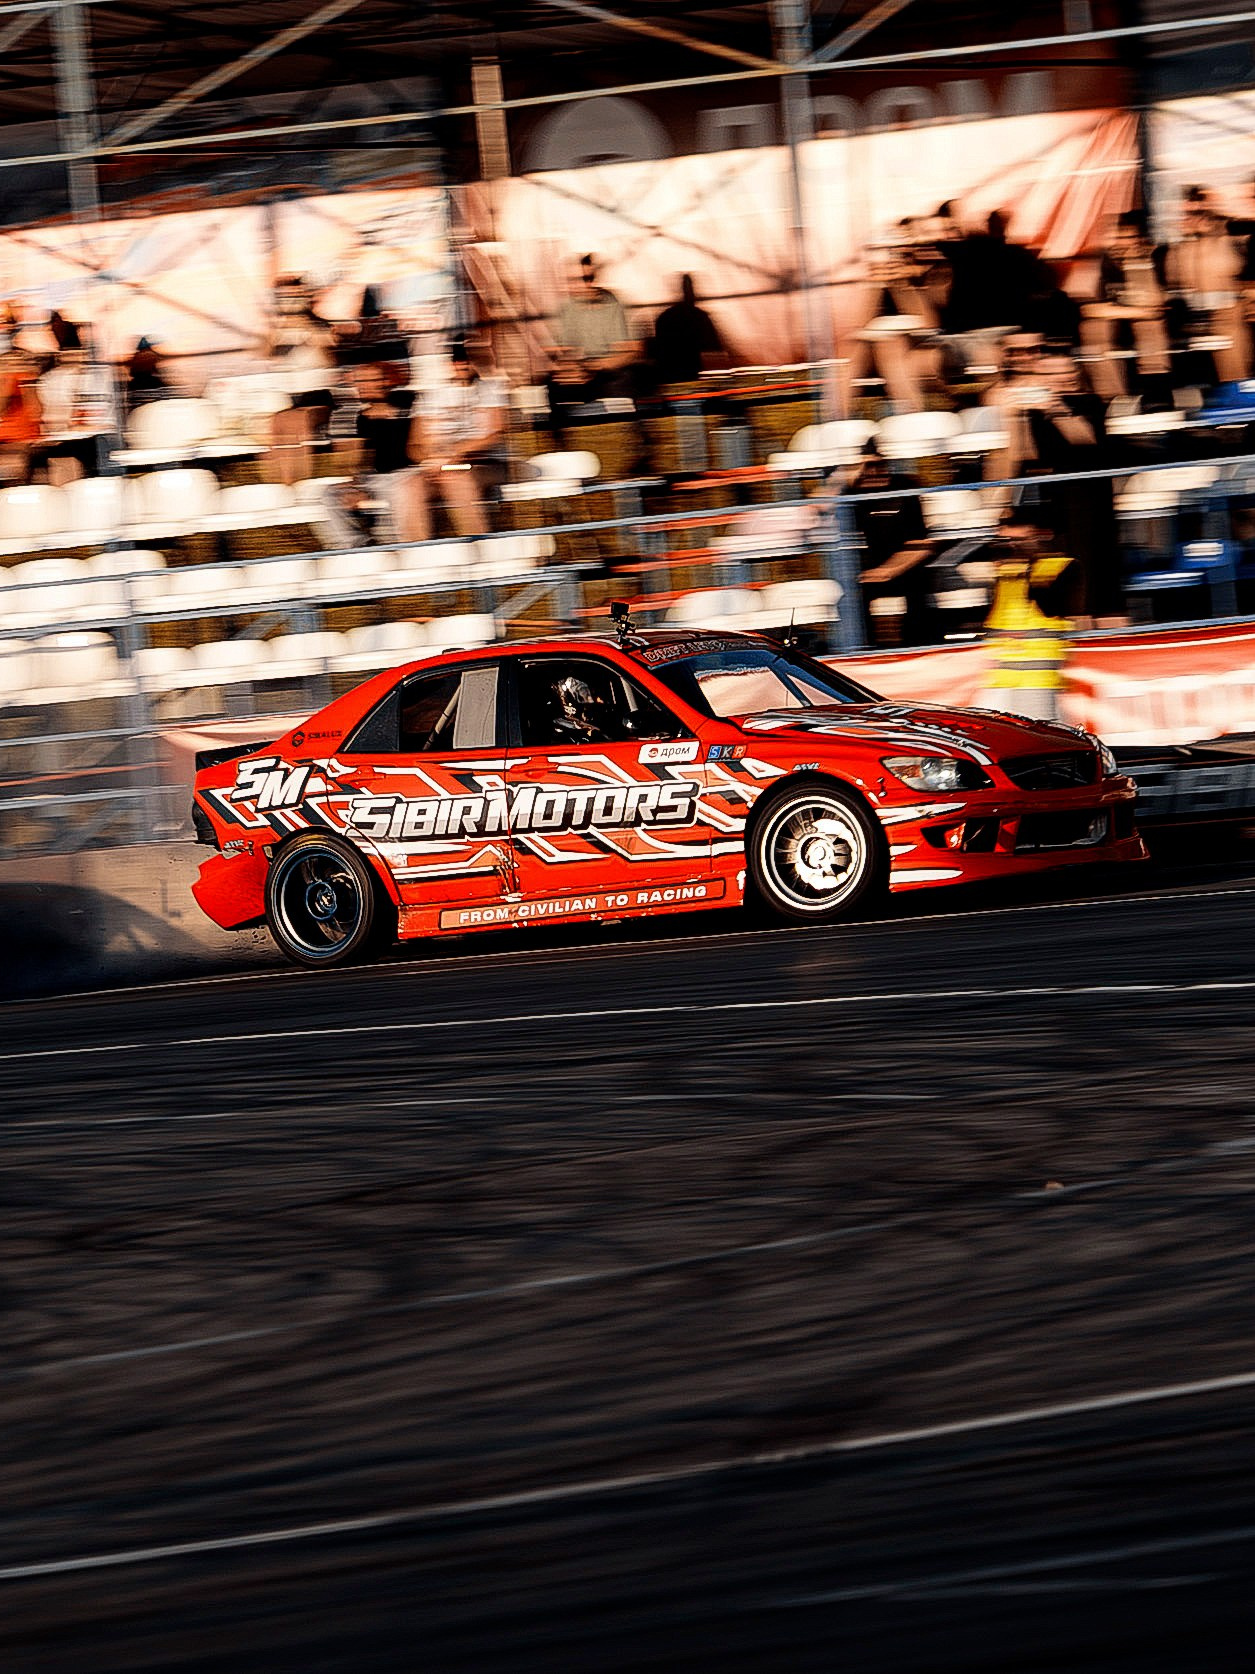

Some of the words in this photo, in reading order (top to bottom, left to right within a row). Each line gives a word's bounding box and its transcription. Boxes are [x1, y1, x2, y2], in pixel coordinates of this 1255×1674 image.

[708, 745, 746, 759] SKR
[230, 757, 311, 810] SM
[459, 907, 510, 924] FROM
[517, 897, 597, 917] CIVILIAN
[604, 893, 629, 907] TO
[636, 885, 707, 904] RACING
